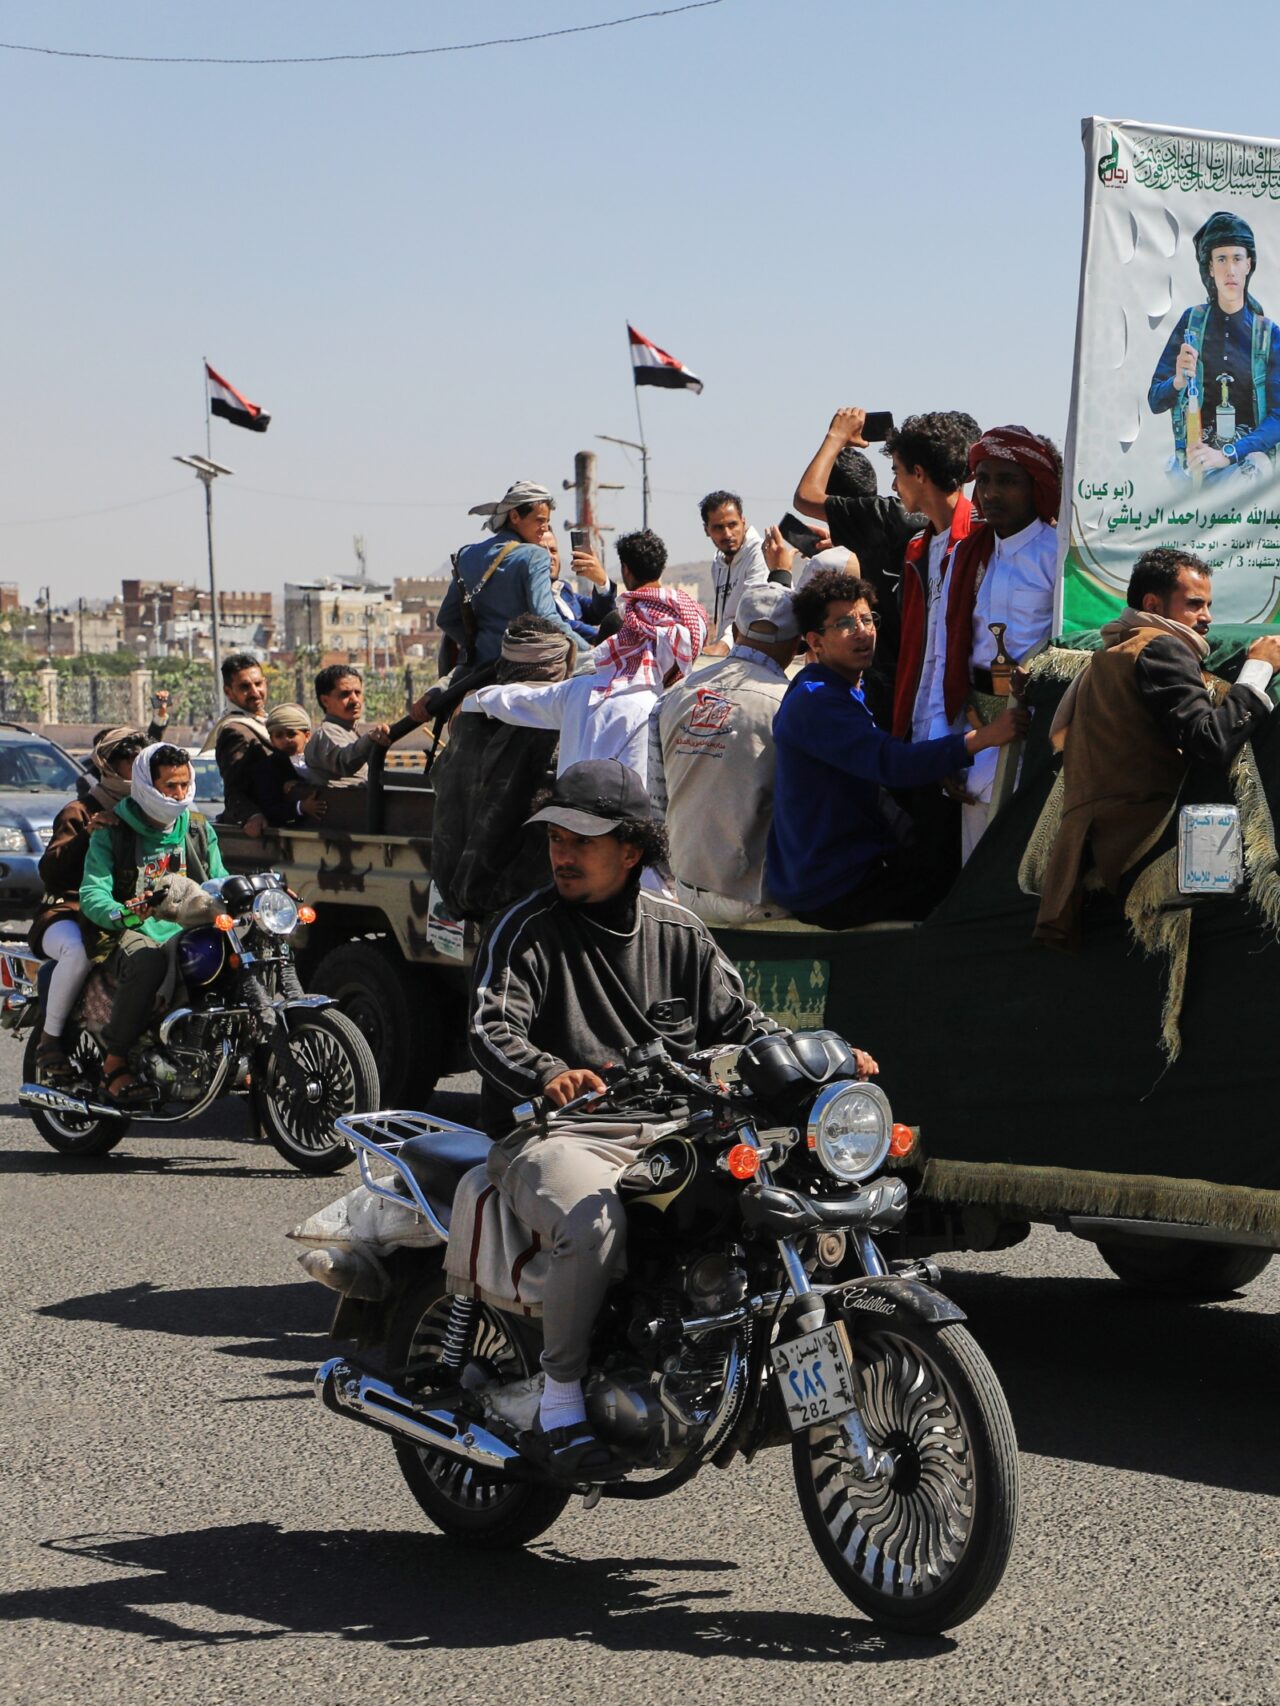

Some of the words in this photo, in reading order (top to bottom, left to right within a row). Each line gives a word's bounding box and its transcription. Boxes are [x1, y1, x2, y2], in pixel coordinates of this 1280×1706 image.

[1236, 556, 1244, 568] 3
[842, 1286, 896, 1315] Cadillac
[796, 1336, 823, 1364] اليمن
[788, 1361, 827, 1402] ٢٨٢
[800, 1398, 830, 1423] 282
